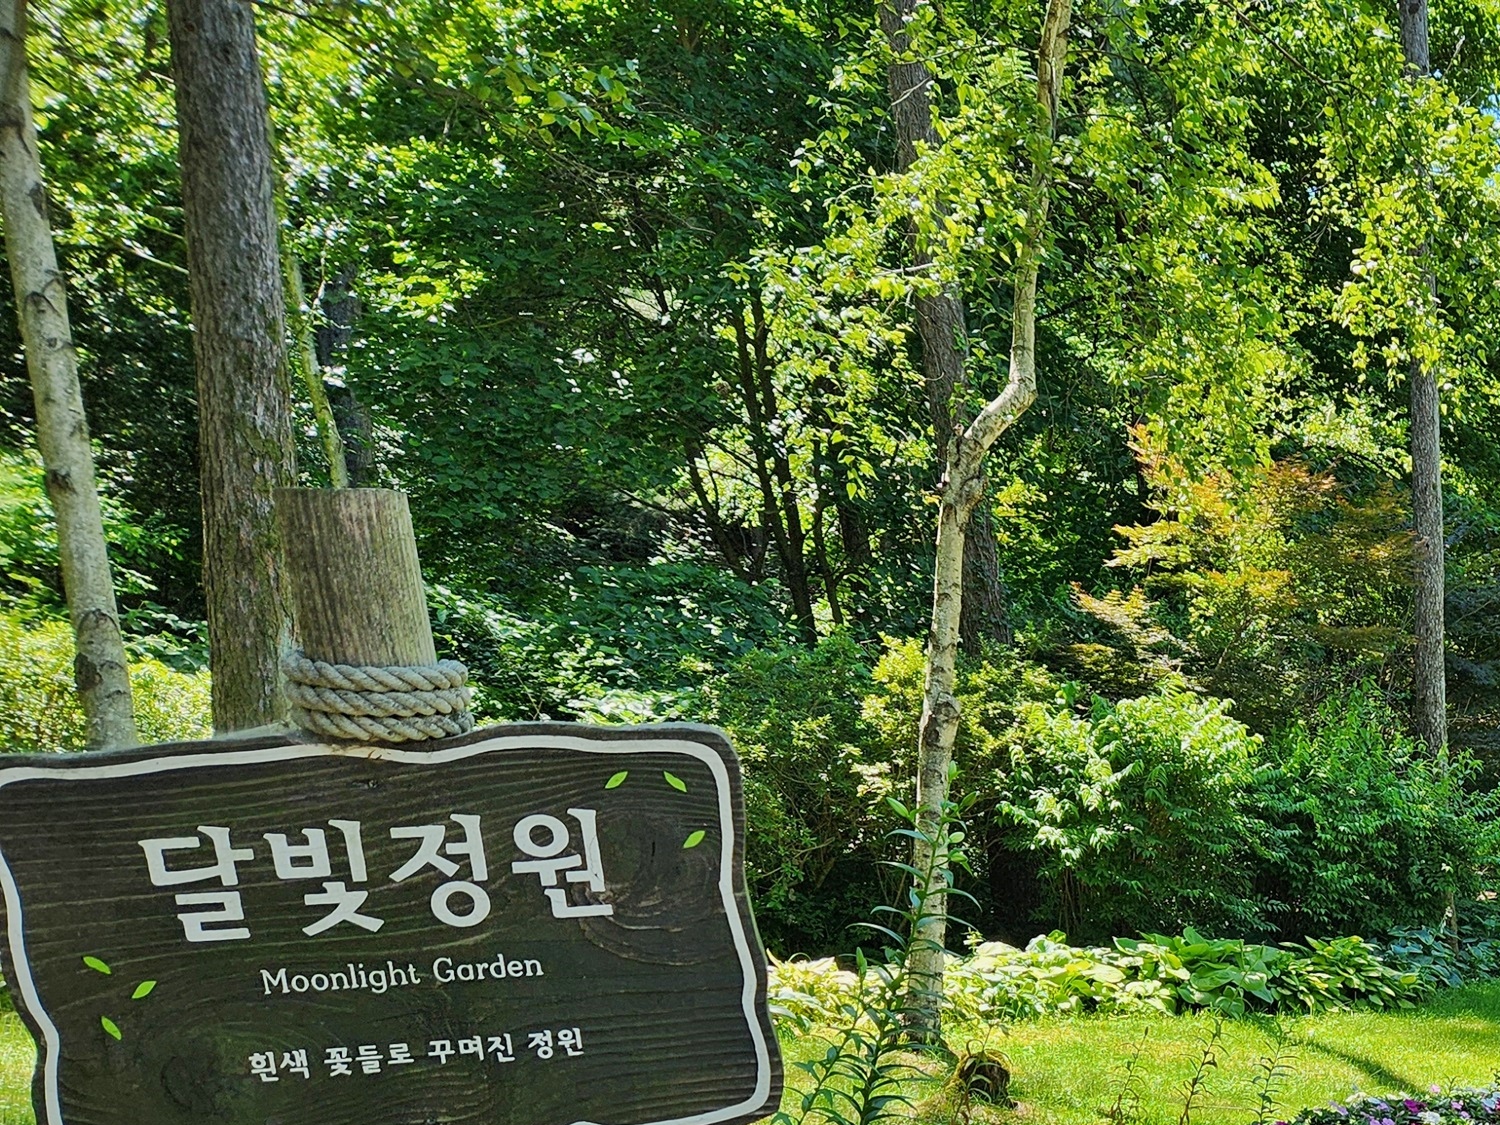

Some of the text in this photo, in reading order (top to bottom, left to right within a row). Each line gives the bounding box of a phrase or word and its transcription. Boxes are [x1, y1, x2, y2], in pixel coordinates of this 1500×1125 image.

[138, 808, 614, 942] 달빛정원
[260, 954, 545, 995] Moonlight Garden
[248, 1027, 585, 1082] 흰색 꽃들로 꾸며진 정원
